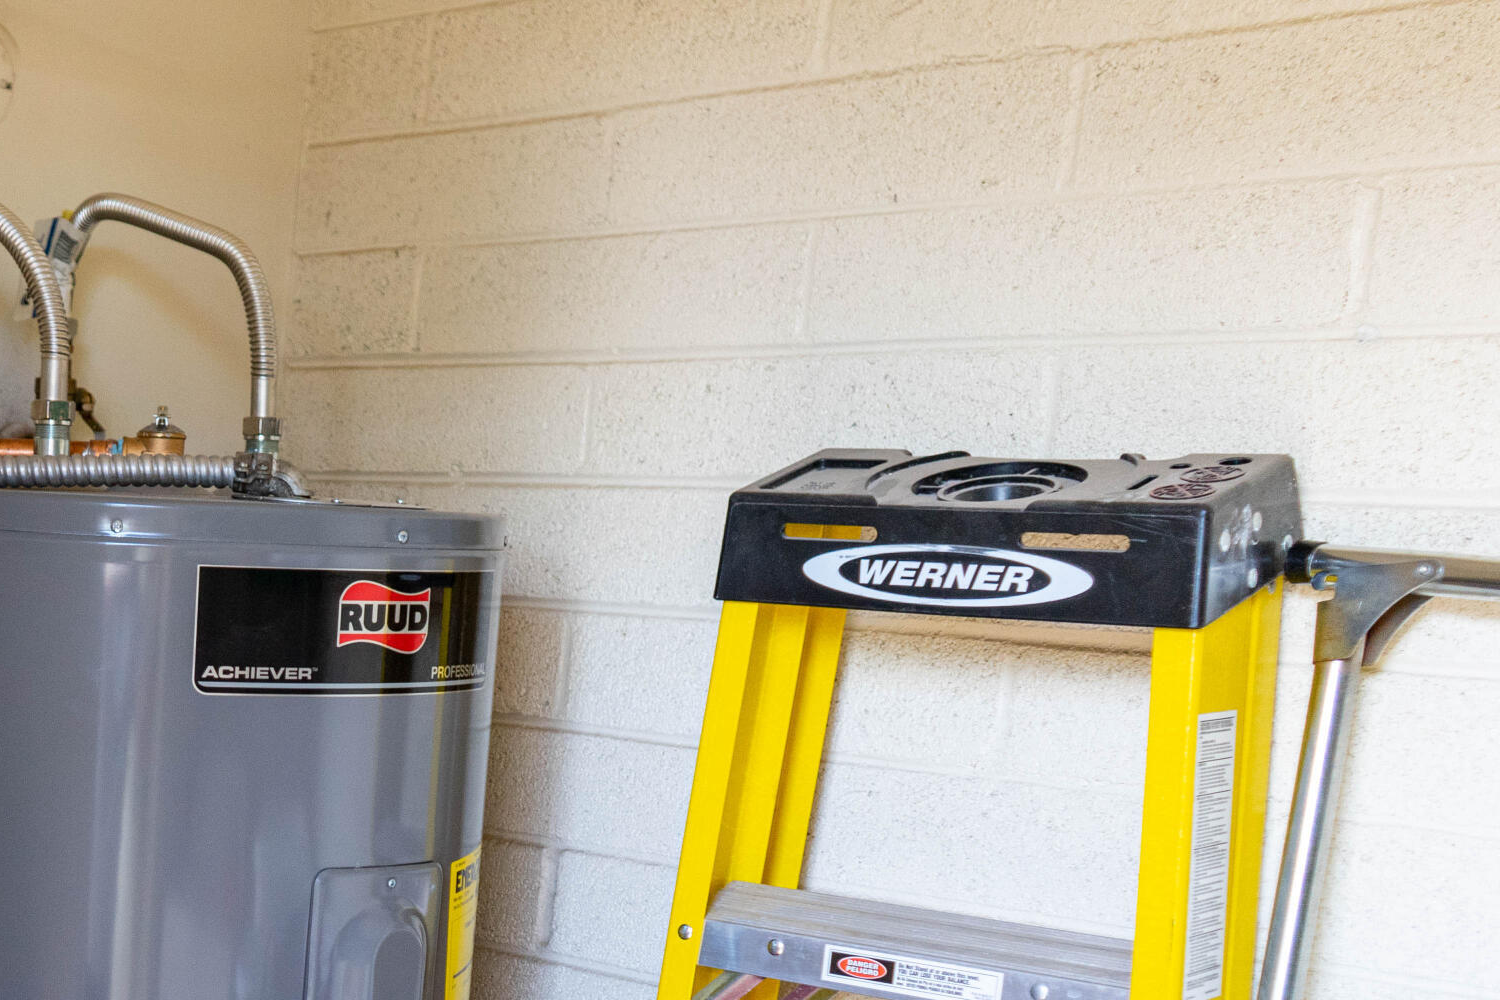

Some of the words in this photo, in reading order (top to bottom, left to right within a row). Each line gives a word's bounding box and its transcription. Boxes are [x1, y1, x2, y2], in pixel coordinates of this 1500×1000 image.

[856, 558, 1035, 595] WERNER
[339, 603, 428, 632] RUUD
[201, 665, 313, 680] ACHIEVER
[845, 965, 879, 977] PELIGRO
[847, 959, 879, 970] DANGER
